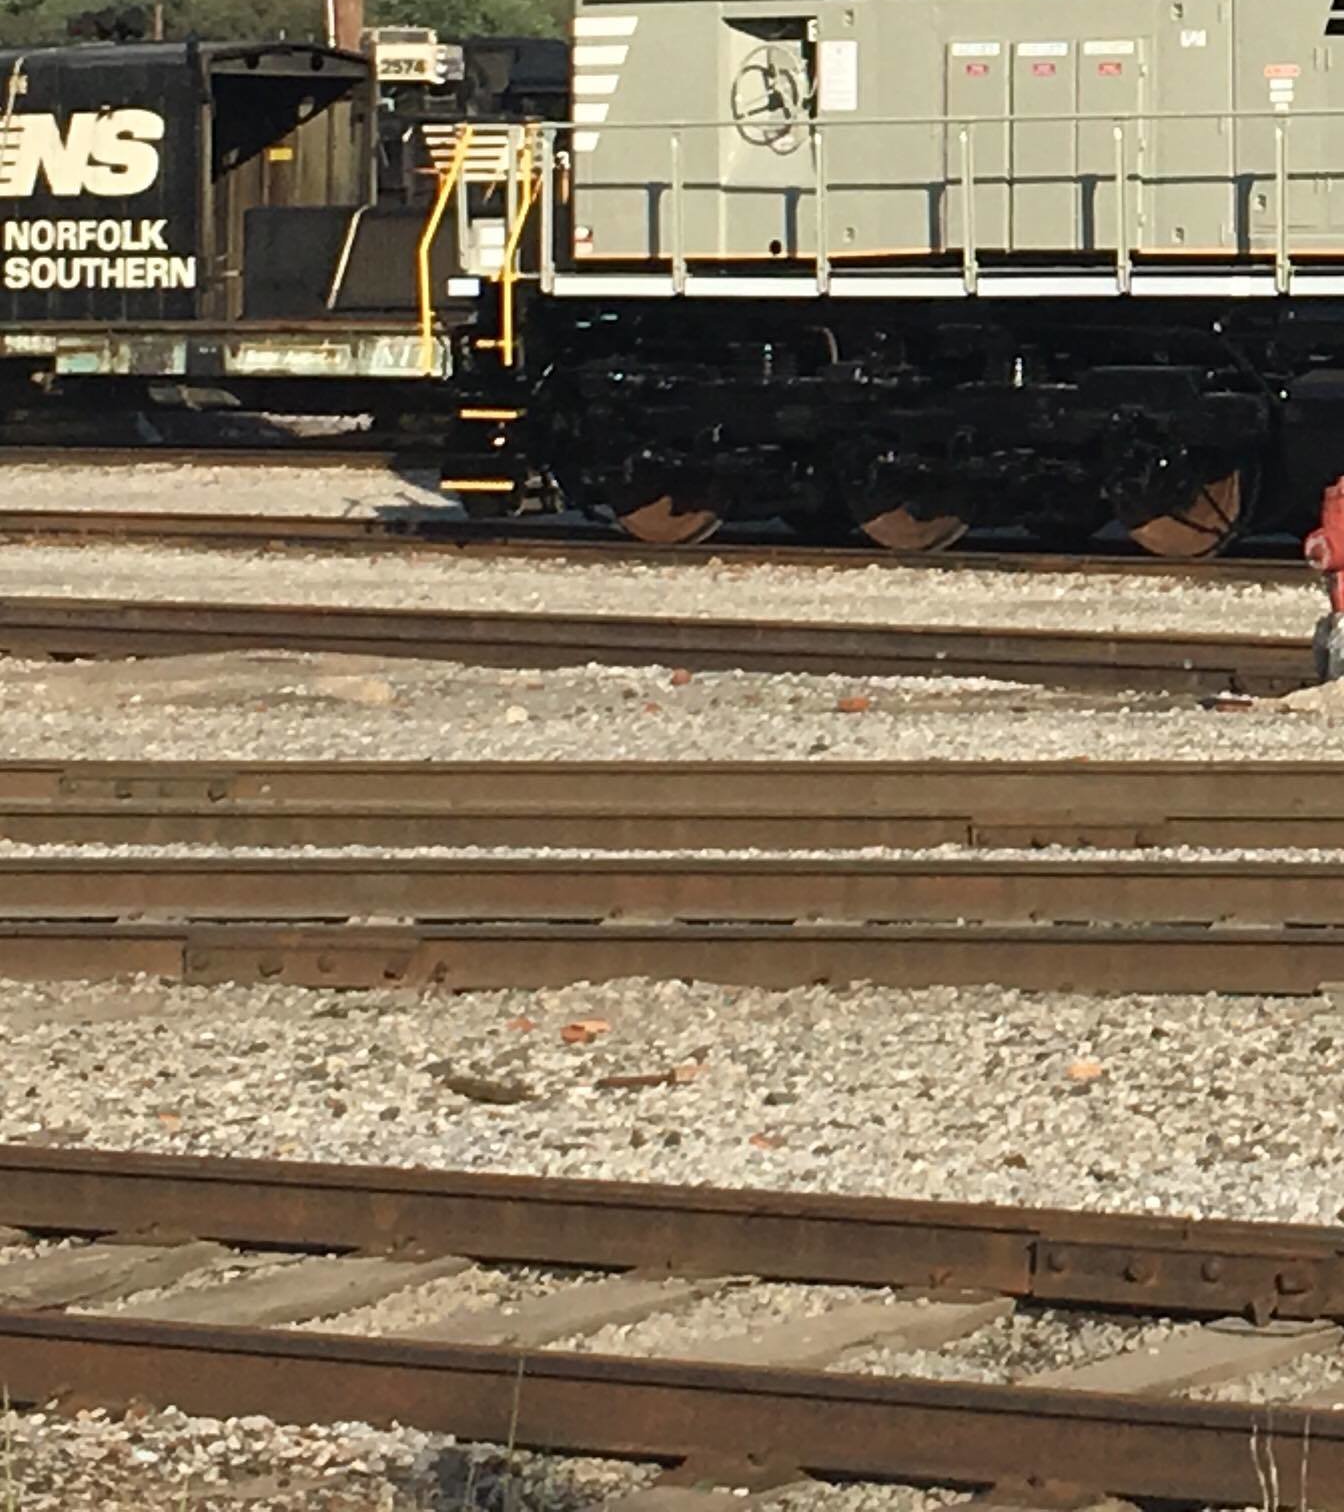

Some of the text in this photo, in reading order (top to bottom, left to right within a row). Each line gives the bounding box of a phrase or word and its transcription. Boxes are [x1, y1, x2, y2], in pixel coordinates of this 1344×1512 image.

[0, 108, 165, 197] NS
[4, 219, 168, 251] NORFOLK
[4, 257, 196, 289] SOUTHERN
